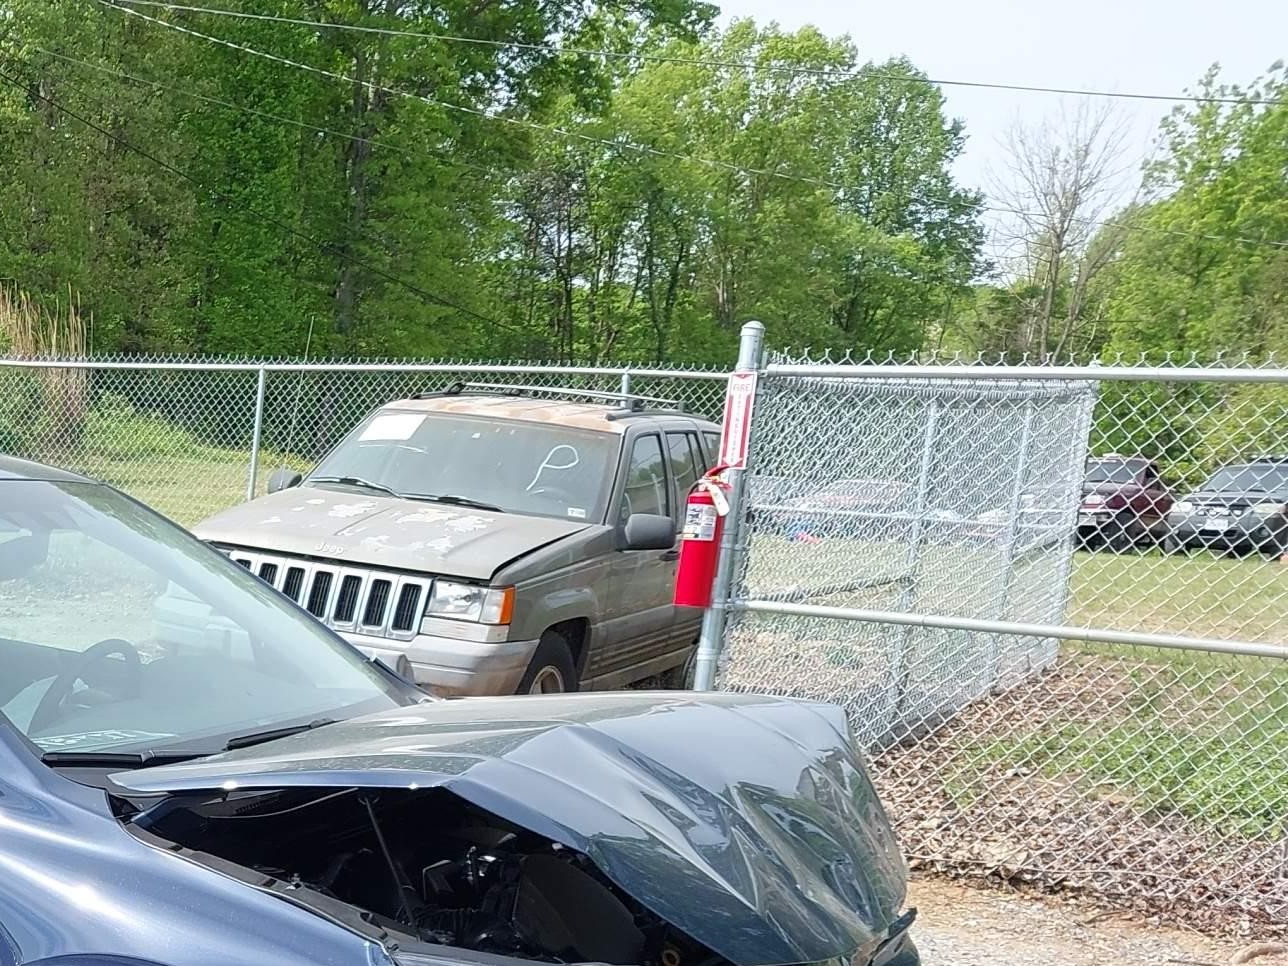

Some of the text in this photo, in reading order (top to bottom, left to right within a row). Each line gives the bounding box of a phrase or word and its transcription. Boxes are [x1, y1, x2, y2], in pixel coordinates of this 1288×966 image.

[732, 383, 751, 392] FIRE
[527, 444, 579, 490] P
[313, 541, 345, 556] Jeep
